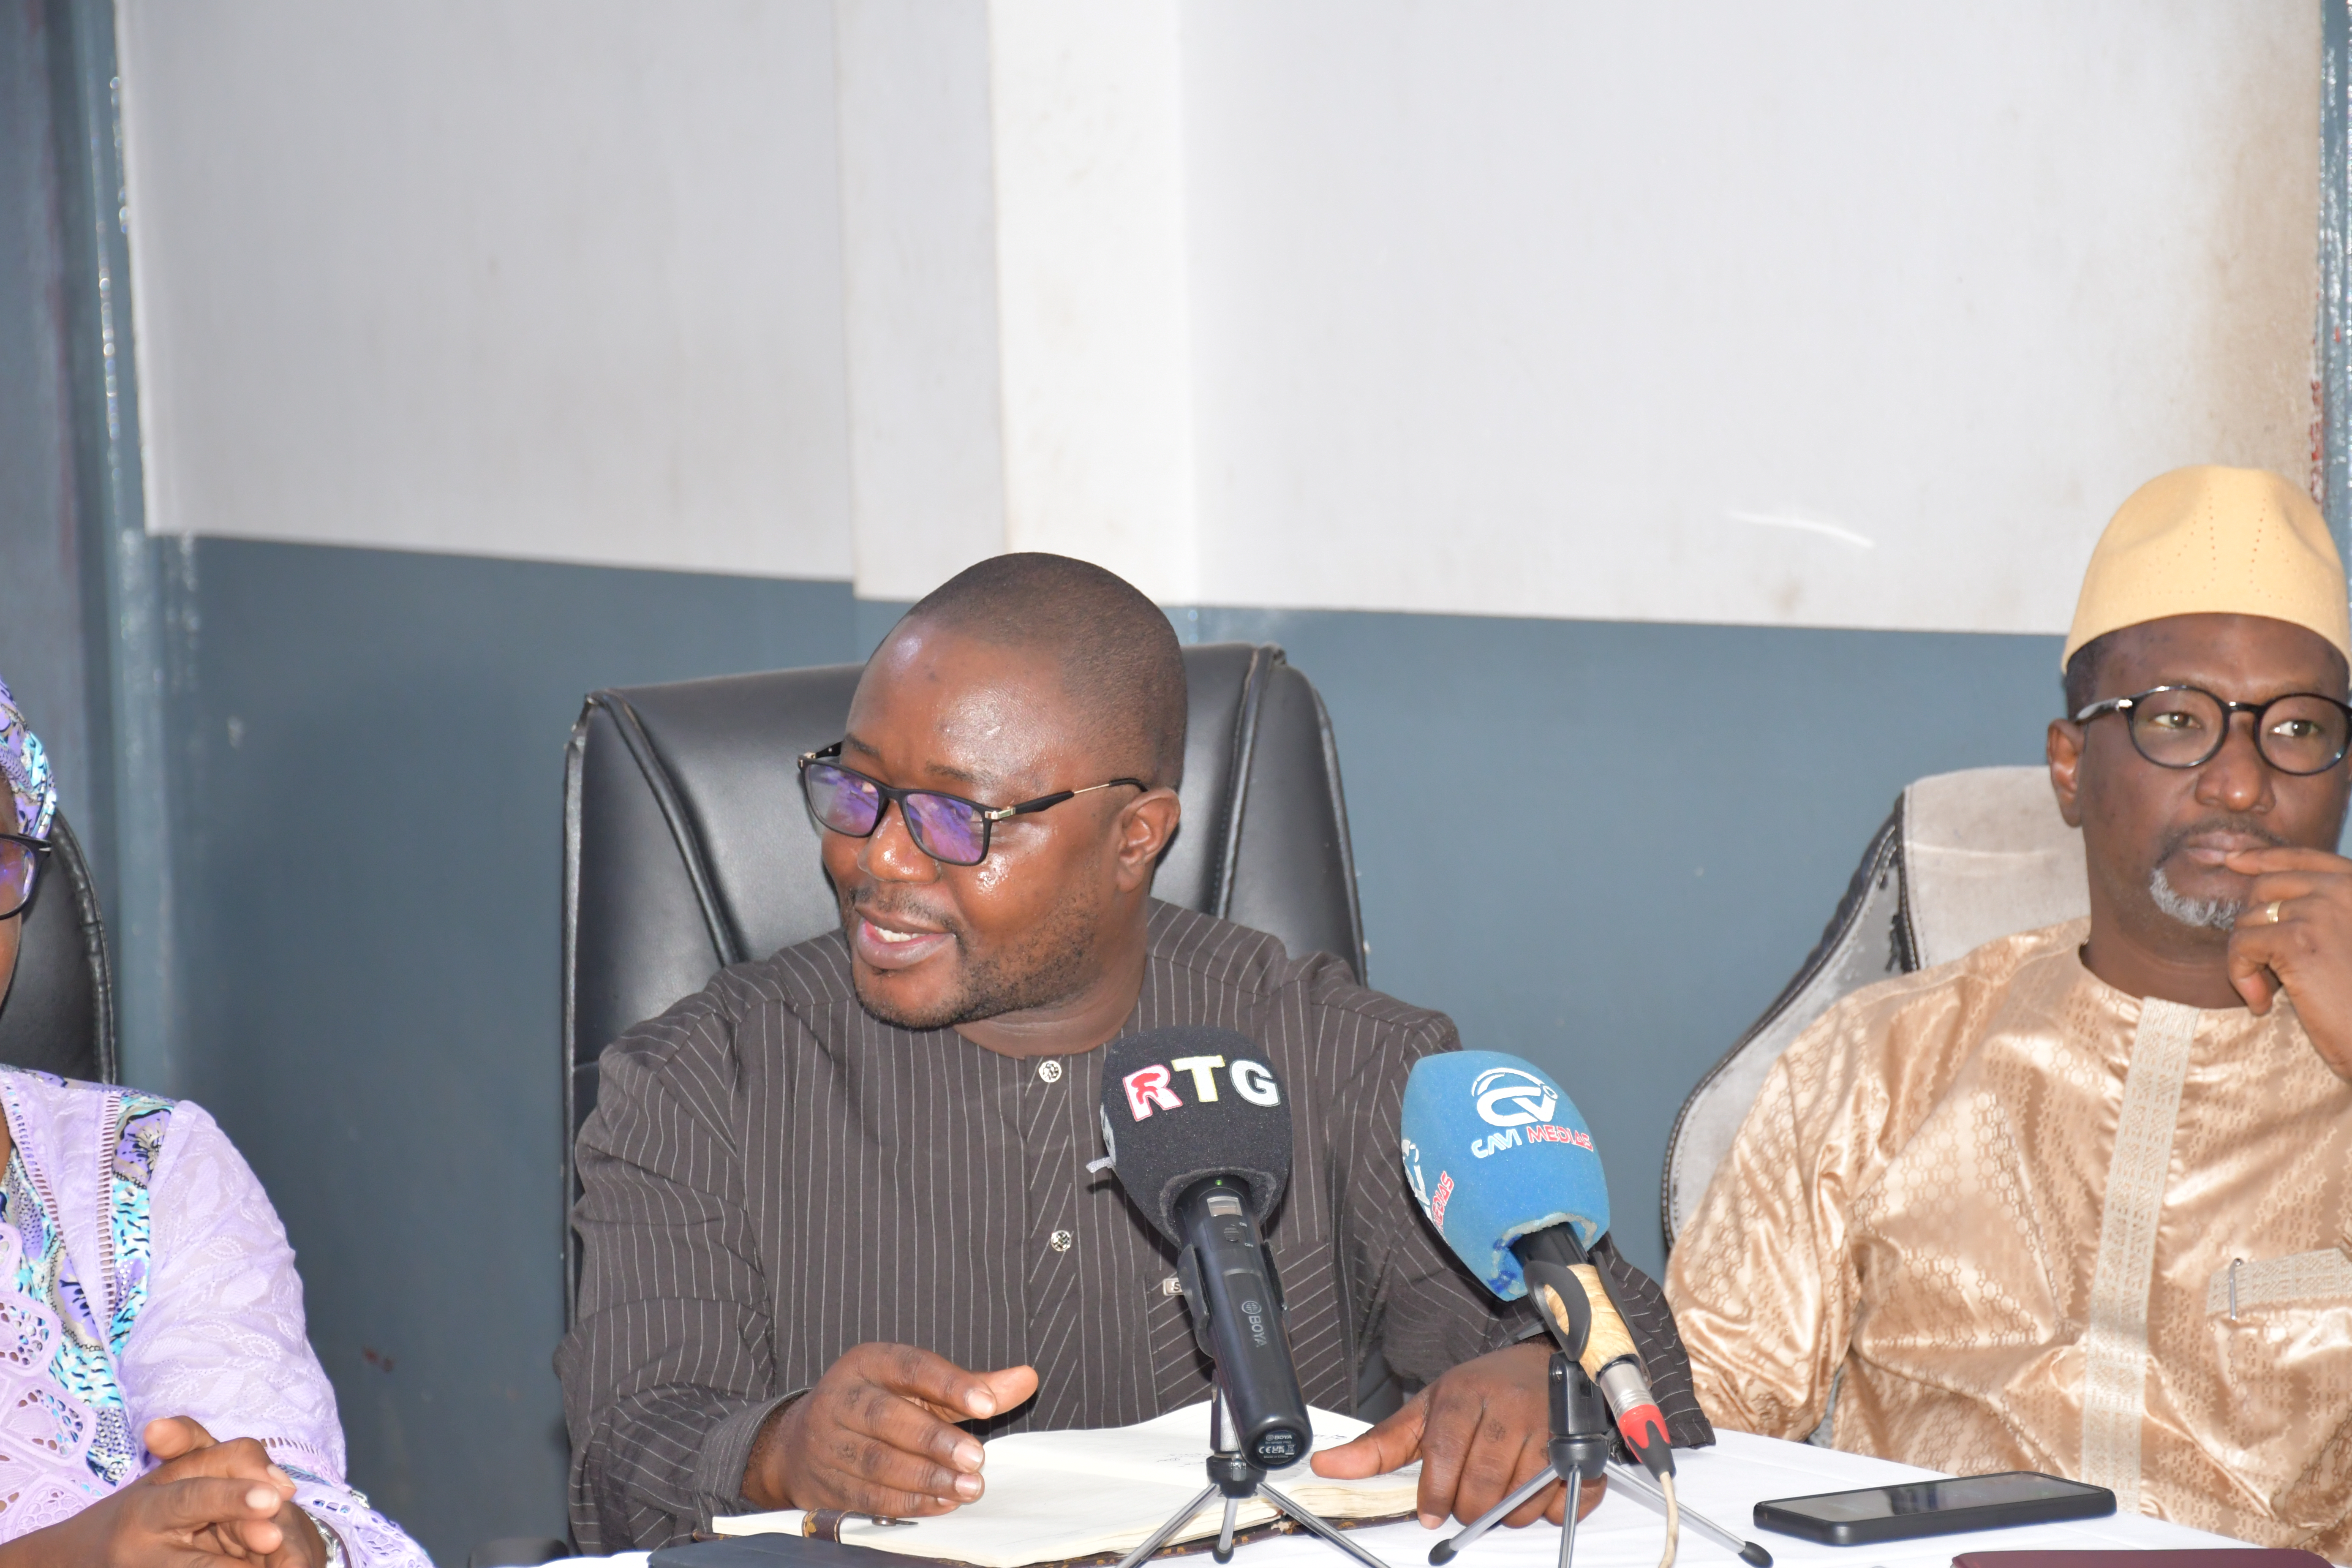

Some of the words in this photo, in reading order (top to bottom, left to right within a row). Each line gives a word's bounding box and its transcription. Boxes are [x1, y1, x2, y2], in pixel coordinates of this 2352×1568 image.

[1122, 1055, 1281, 1122] RTG
[1471, 1128, 1523, 1158] CAVI
[1526, 1124, 1594, 1152] MEDIAS
[1249, 1316, 1267, 1348] BOYA
